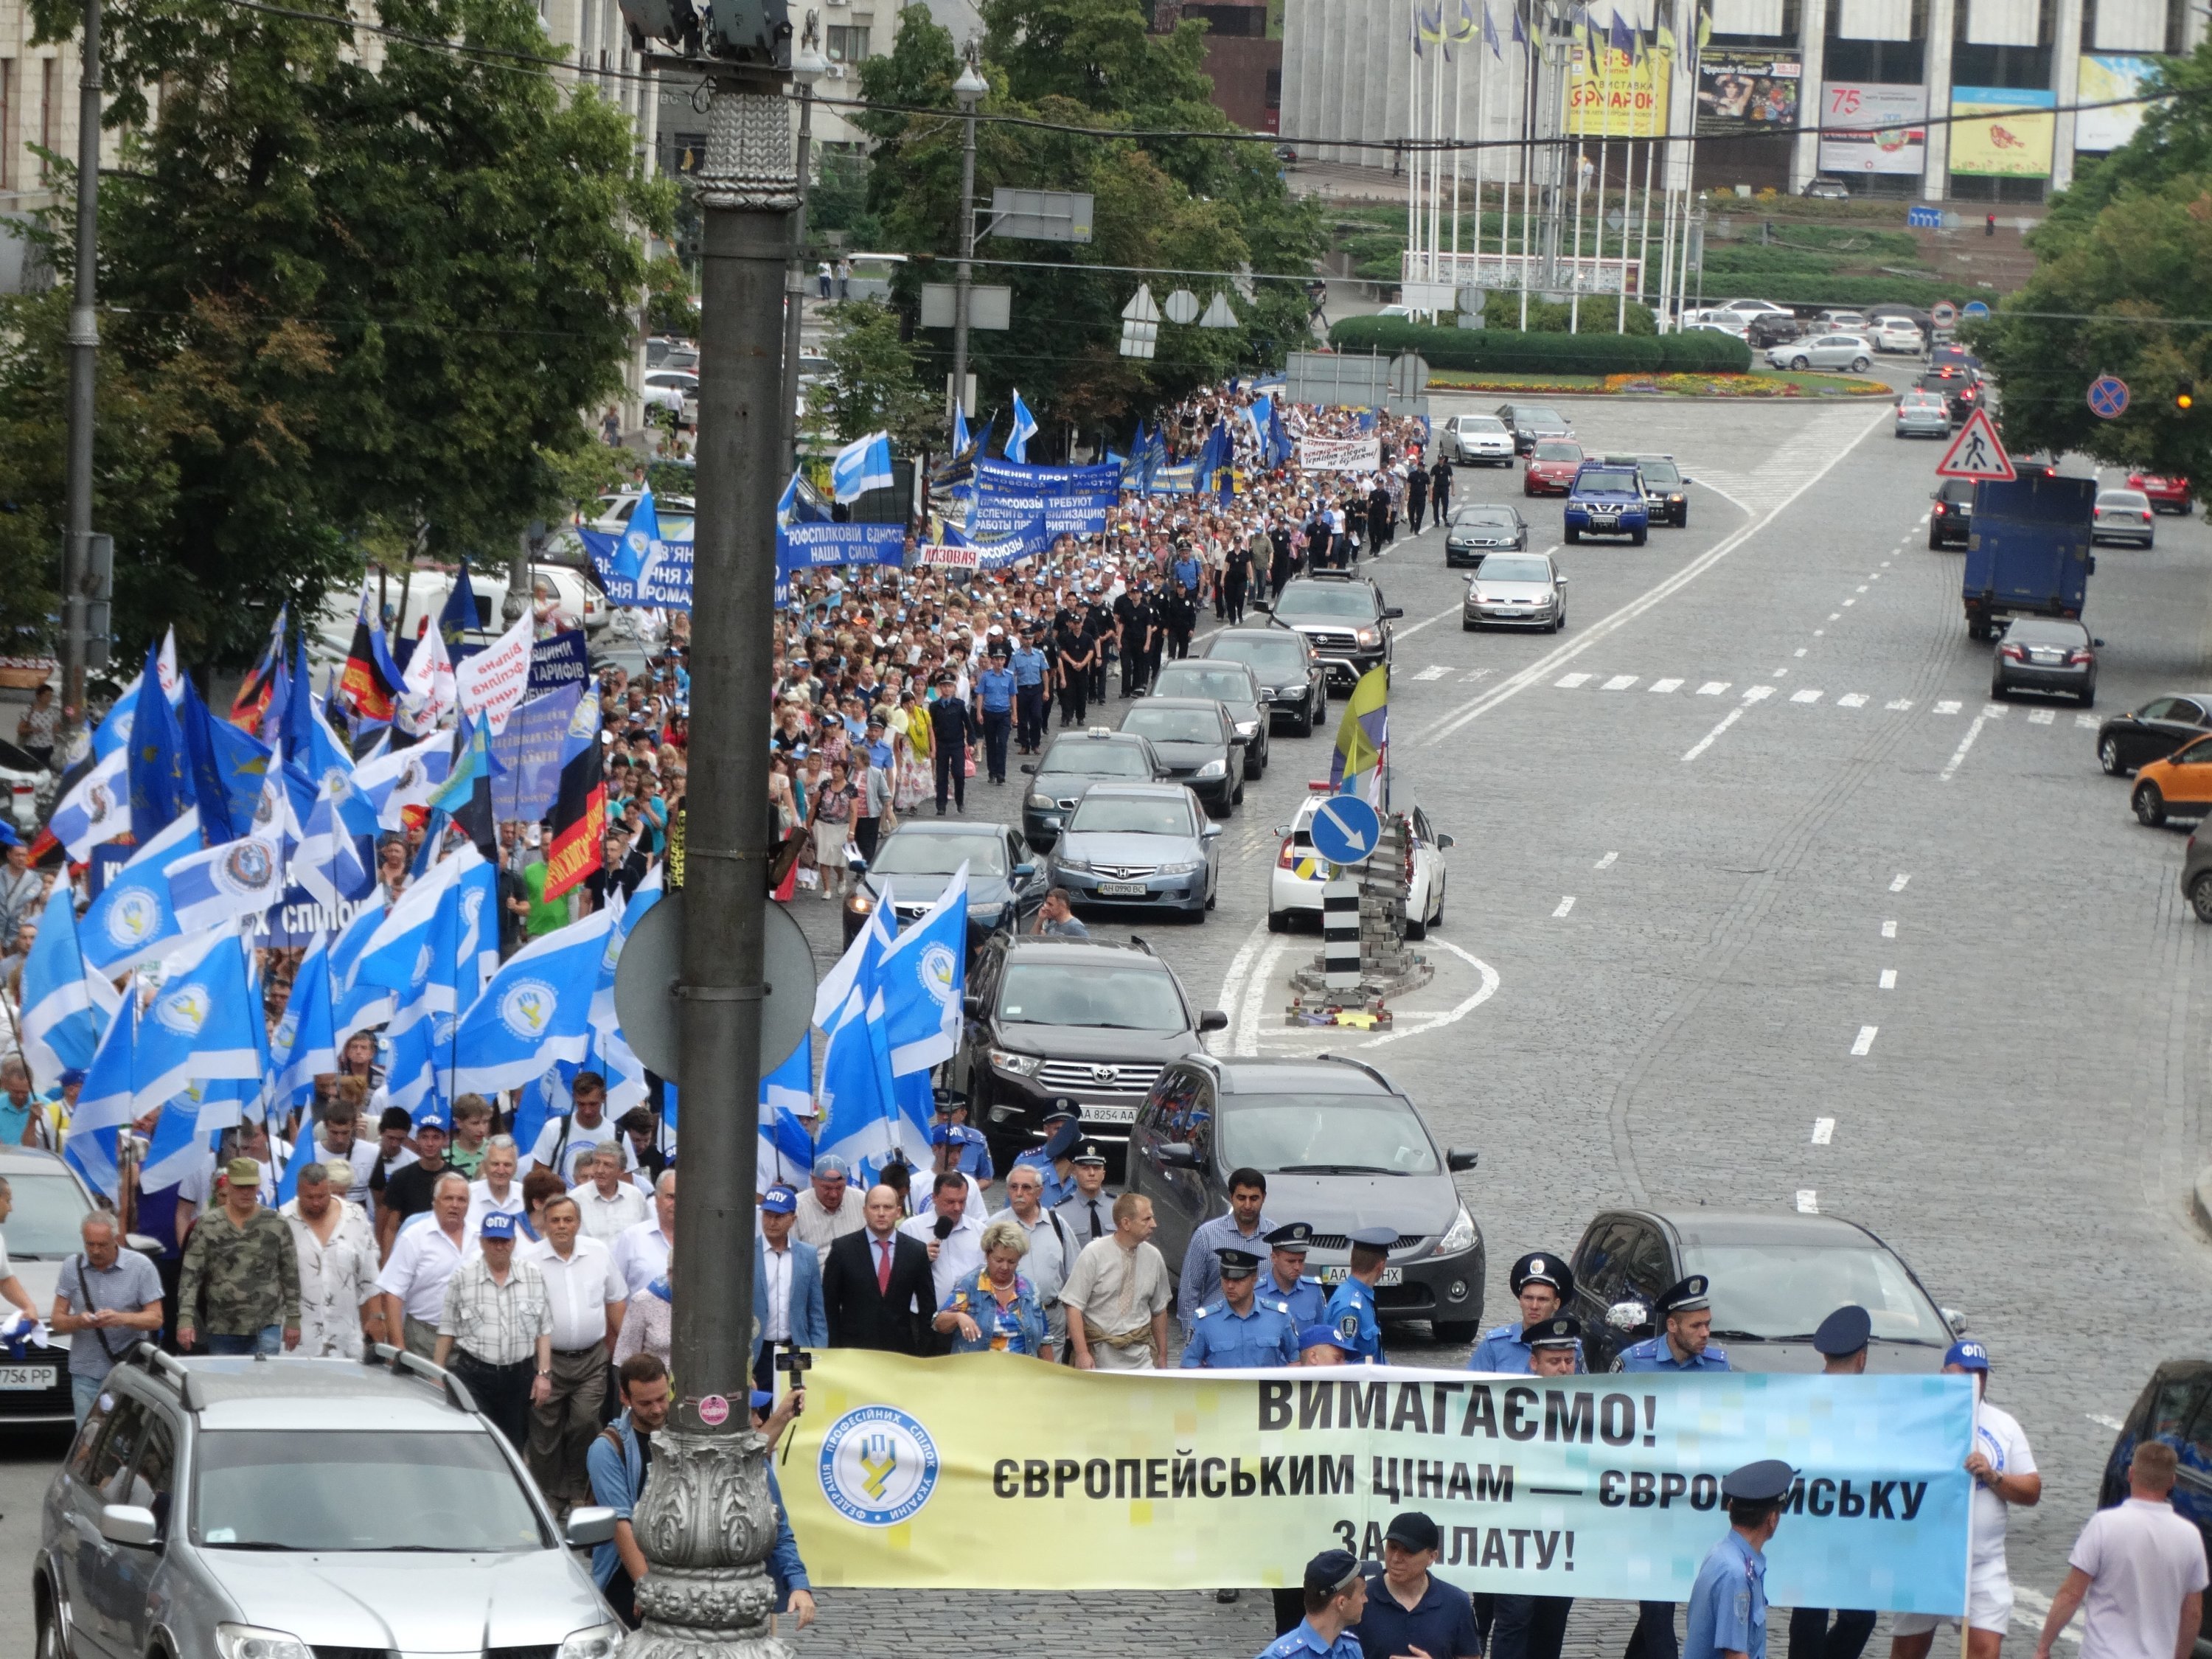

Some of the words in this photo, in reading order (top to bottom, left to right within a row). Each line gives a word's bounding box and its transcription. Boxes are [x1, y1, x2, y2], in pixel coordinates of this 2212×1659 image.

[1832, 88, 1860, 115] 75
[1048, 496, 1093, 509] ТРЕБУЮТ
[1028, 508, 1106, 521] СТБИЛИЗАЦИЮ
[975, 519, 1012, 530] РАБОТЫ
[1014, 520, 1087, 532] ПРЕРИЯТИЙ!
[788, 525, 862, 547] РОФСПІЛКОВІЙ
[810, 547, 841, 563] НАША
[848, 544, 879, 560] СИЛА!
[1102, 885, 1114, 894] AH
[1115, 885, 1132, 894] 0990
[1133, 885, 1144, 894] BC
[1079, 1107, 1093, 1119] AA
[1093, 1107, 1115, 1120] 8254
[1117, 1108, 1135, 1120] AA
[665, 1146, 678, 1158] ФП
[765, 1190, 787, 1203] ФПУ
[485, 1216, 510, 1229] ФПУ
[1329, 1267, 1348, 1281] AA
[31, 1368, 52, 1383] PP
[1257, 1379, 1658, 1448] ВИМАГАЄМО!
[826, 1408, 902, 1453] ПРОФЕСІЙНИХ
[909, 1425, 936, 1468] СПІЛОК
[822, 1464, 866, 1520] ФЕДЕРАЦІЯ
[992, 1448, 1356, 1500] ЄВРОПЕЙСЬКИМ
[1372, 1455, 1515, 1506] ЦІНАМ
[1598, 1468, 1929, 1521] ЄВРОЙСЬКУ
[889, 1478, 933, 1520] УКРАЇНИ
[1332, 1519, 1576, 1572] ЗАЛАТУ!
